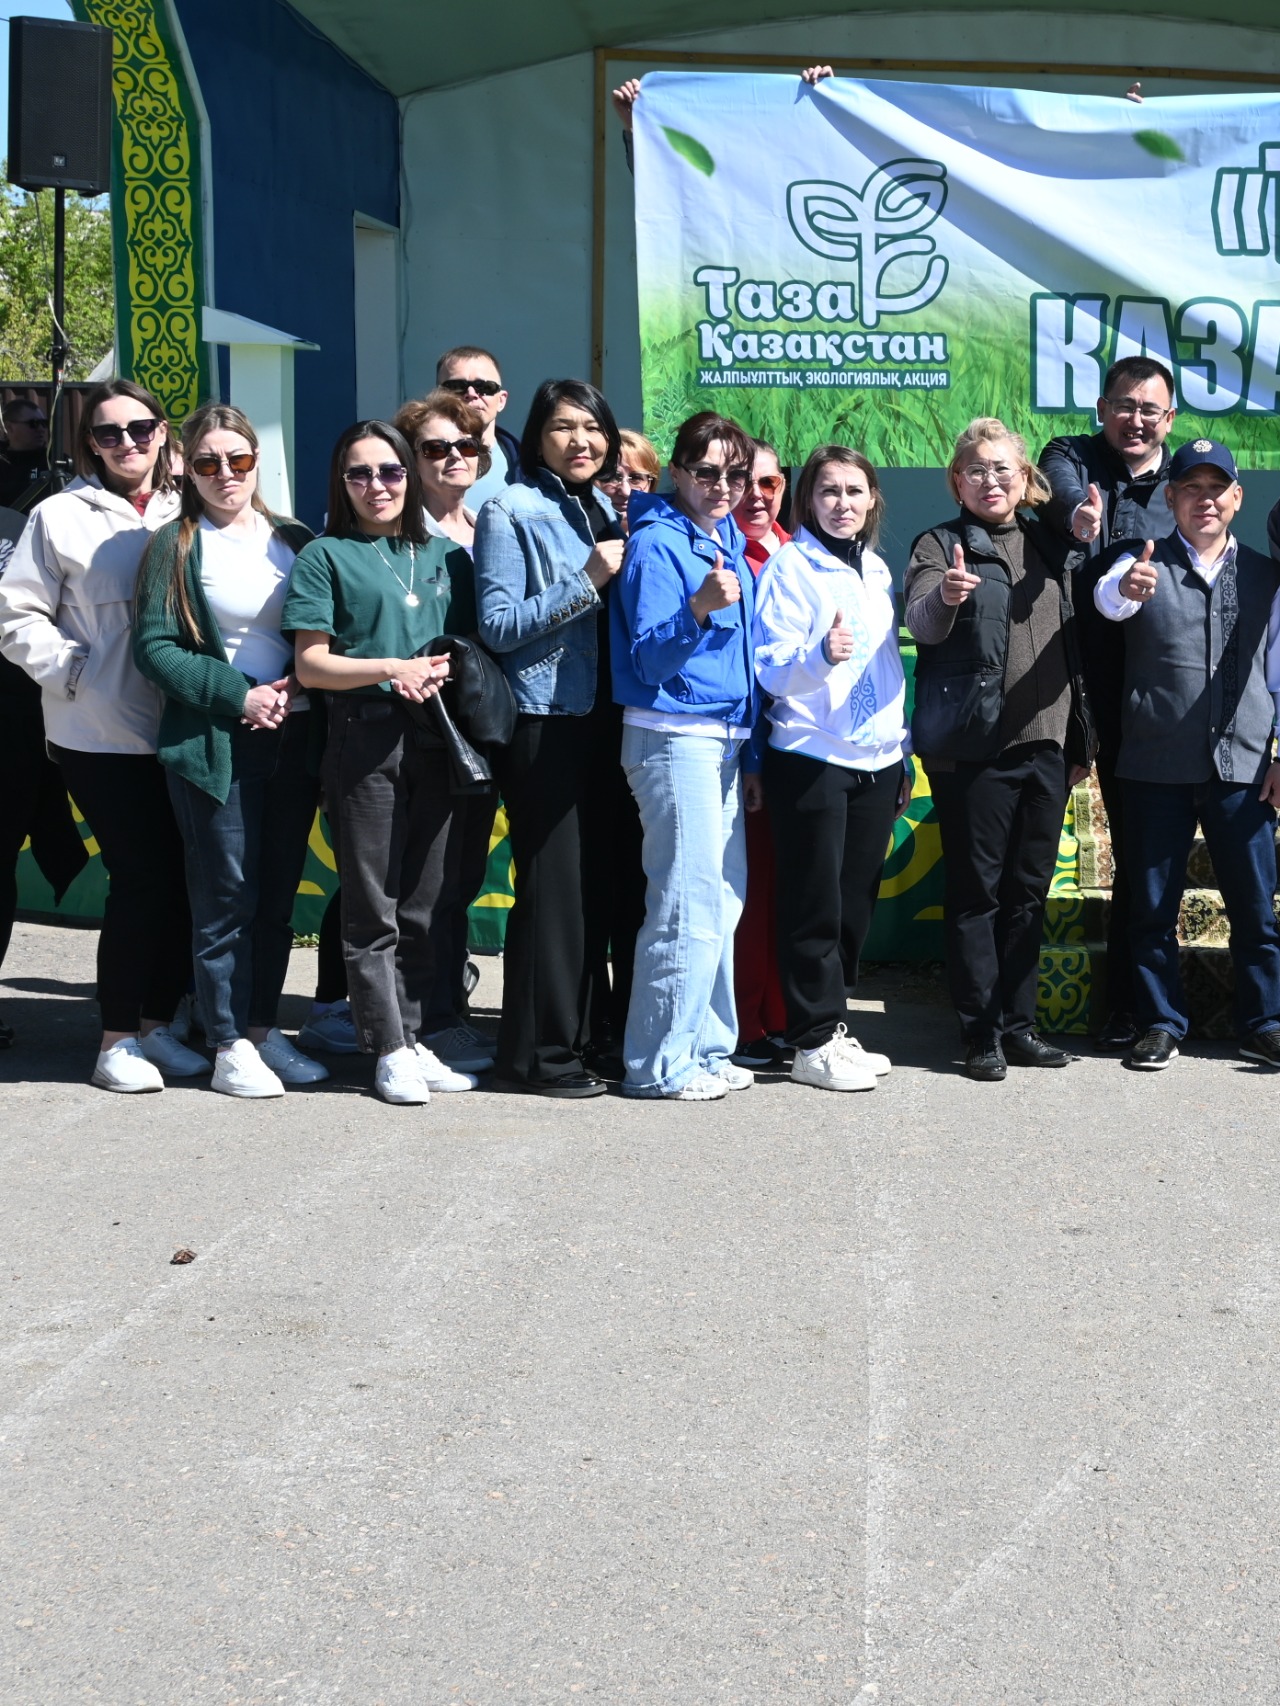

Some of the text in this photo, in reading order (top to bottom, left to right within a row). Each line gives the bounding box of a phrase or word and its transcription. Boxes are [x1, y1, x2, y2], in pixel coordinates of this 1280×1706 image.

[695, 266, 857, 322] Таза
[697, 321, 947, 367] Қазақстан
[700, 370, 947, 388] ЖАЛПЫҰЛТТЫҚ ЭКОЛОГИЯЛЫҚ АКЦИЯ
